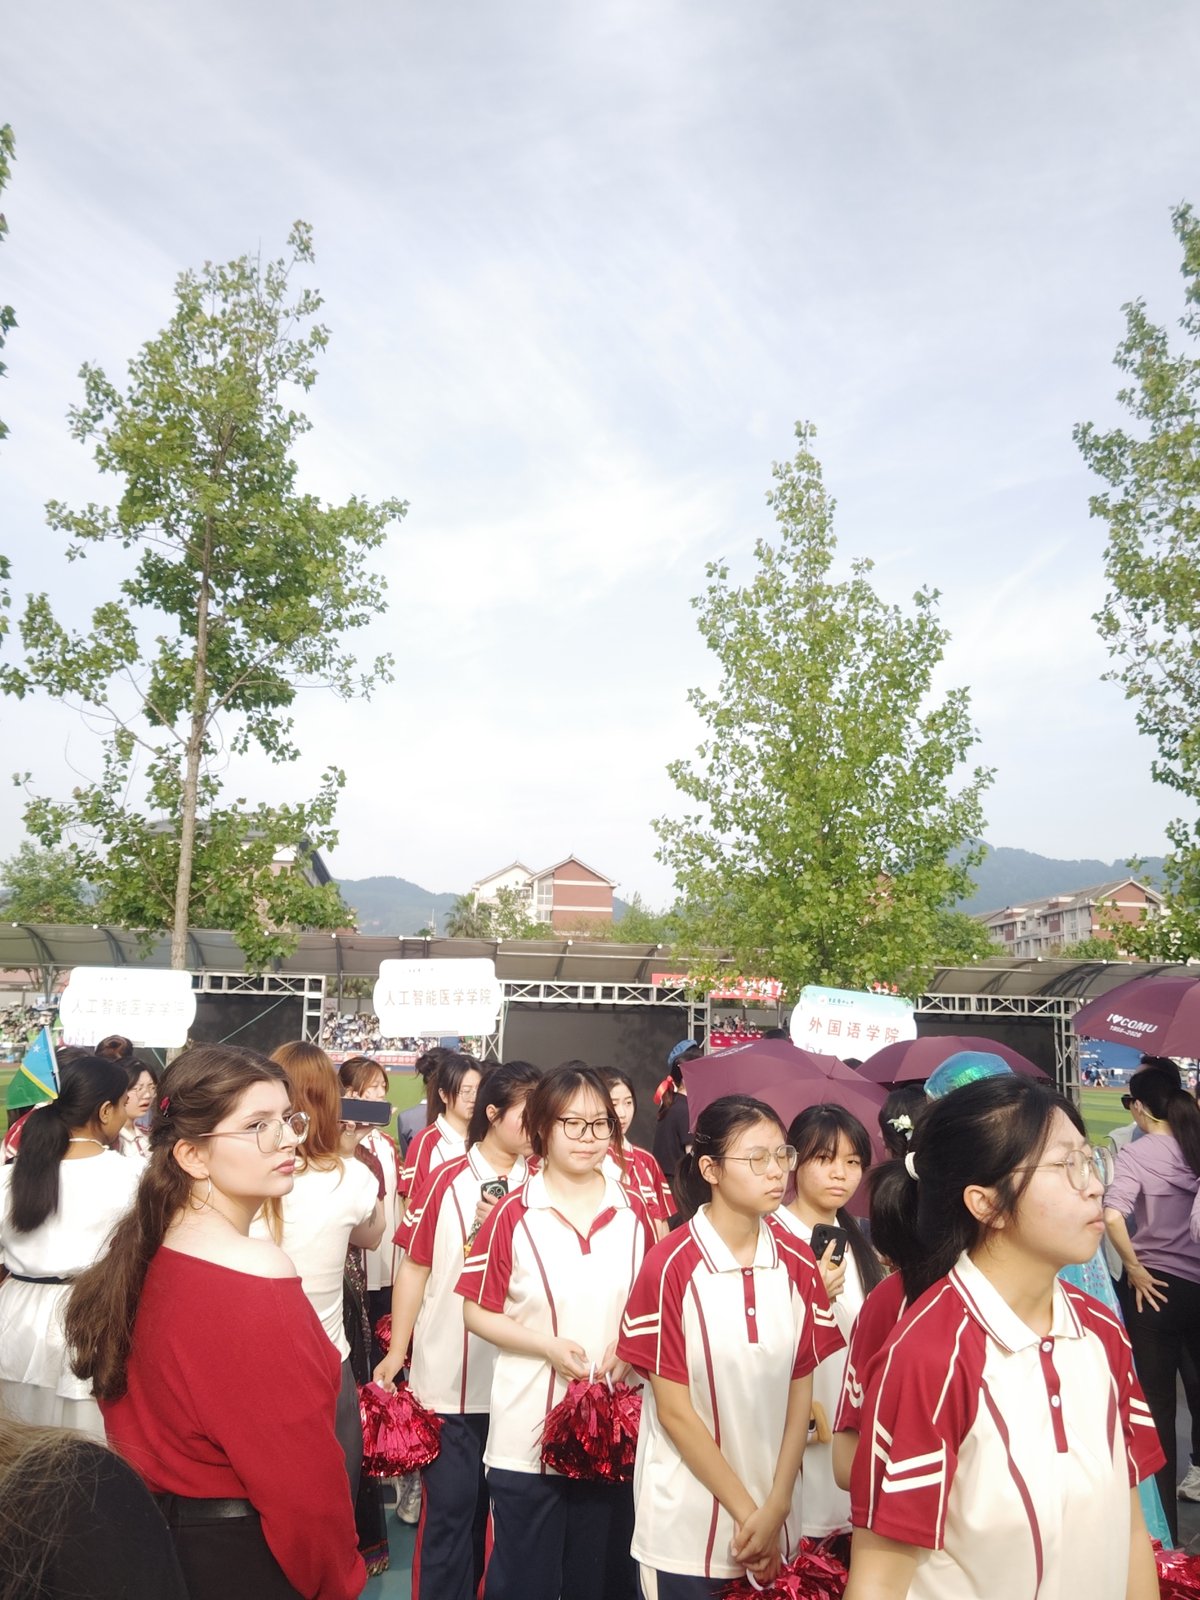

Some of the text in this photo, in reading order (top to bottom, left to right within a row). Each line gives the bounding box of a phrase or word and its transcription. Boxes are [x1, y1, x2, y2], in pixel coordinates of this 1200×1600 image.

[384, 987, 492, 1006] 人工智能医学学院
[808, 1016, 900, 1043] 外国语学院
